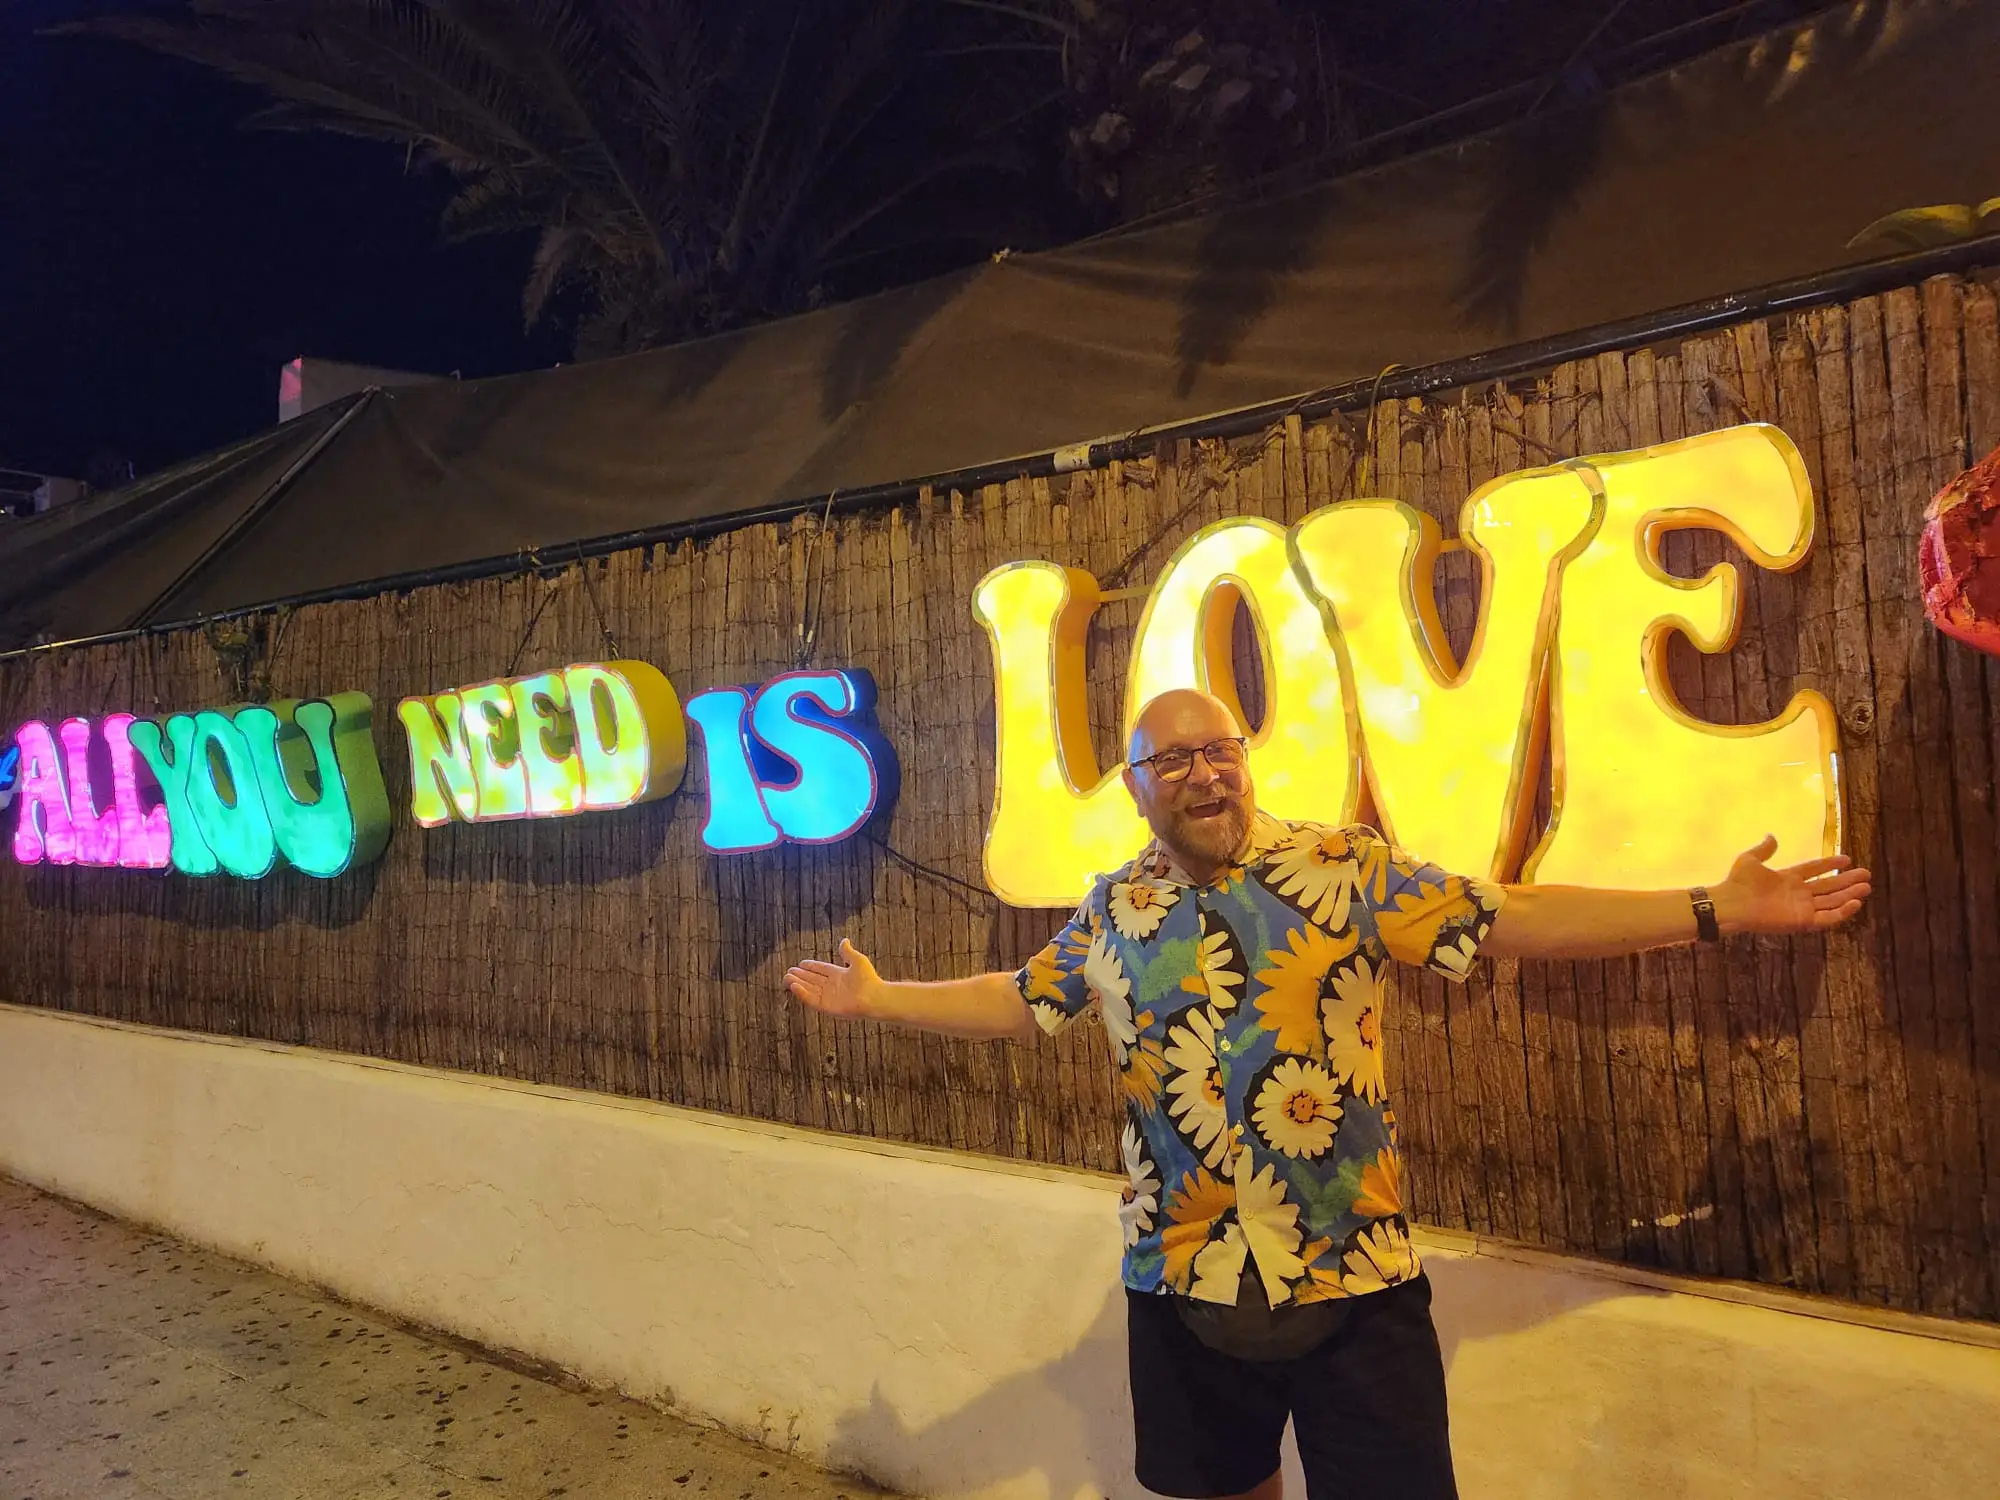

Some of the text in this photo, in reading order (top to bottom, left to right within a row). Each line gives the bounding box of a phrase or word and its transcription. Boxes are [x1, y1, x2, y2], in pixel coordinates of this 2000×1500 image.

[14, 422, 1842, 909] ALL YOU NEED IS LOVE
